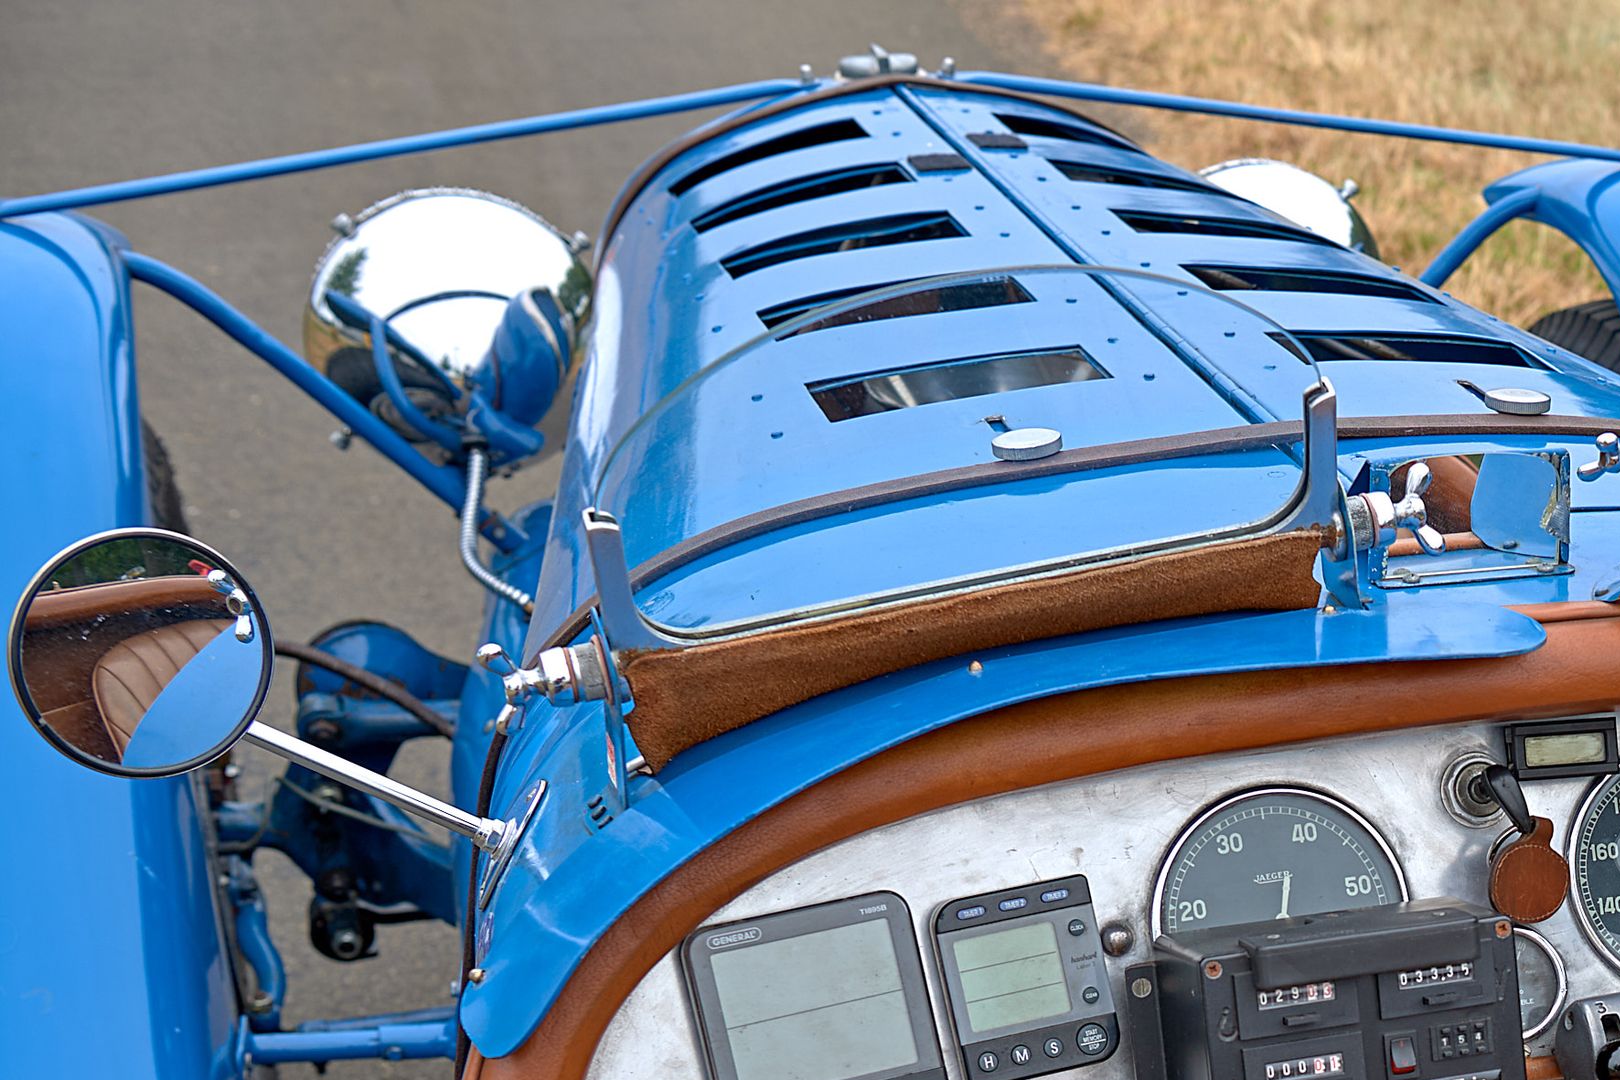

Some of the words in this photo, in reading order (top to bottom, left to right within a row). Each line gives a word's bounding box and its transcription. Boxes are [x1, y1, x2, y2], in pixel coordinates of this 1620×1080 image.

[1590, 842, 1619, 861] 160
[1179, 900, 1207, 922] 20
[1216, 832, 1243, 855] 30
[1292, 822, 1317, 843] 40
[1344, 875, 1372, 897] 50
[1254, 871, 1293, 883] JAEGER
[712, 930, 756, 946] GENERAL
[1595, 1001, 1607, 1014] 3
[1083, 1034, 1102, 1043] MEMORY
[1085, 1029, 1098, 1037] START
[1050, 1042, 1059, 1054] S
[1016, 1049, 1029, 1062] M
[984, 1056, 993, 1069] H
